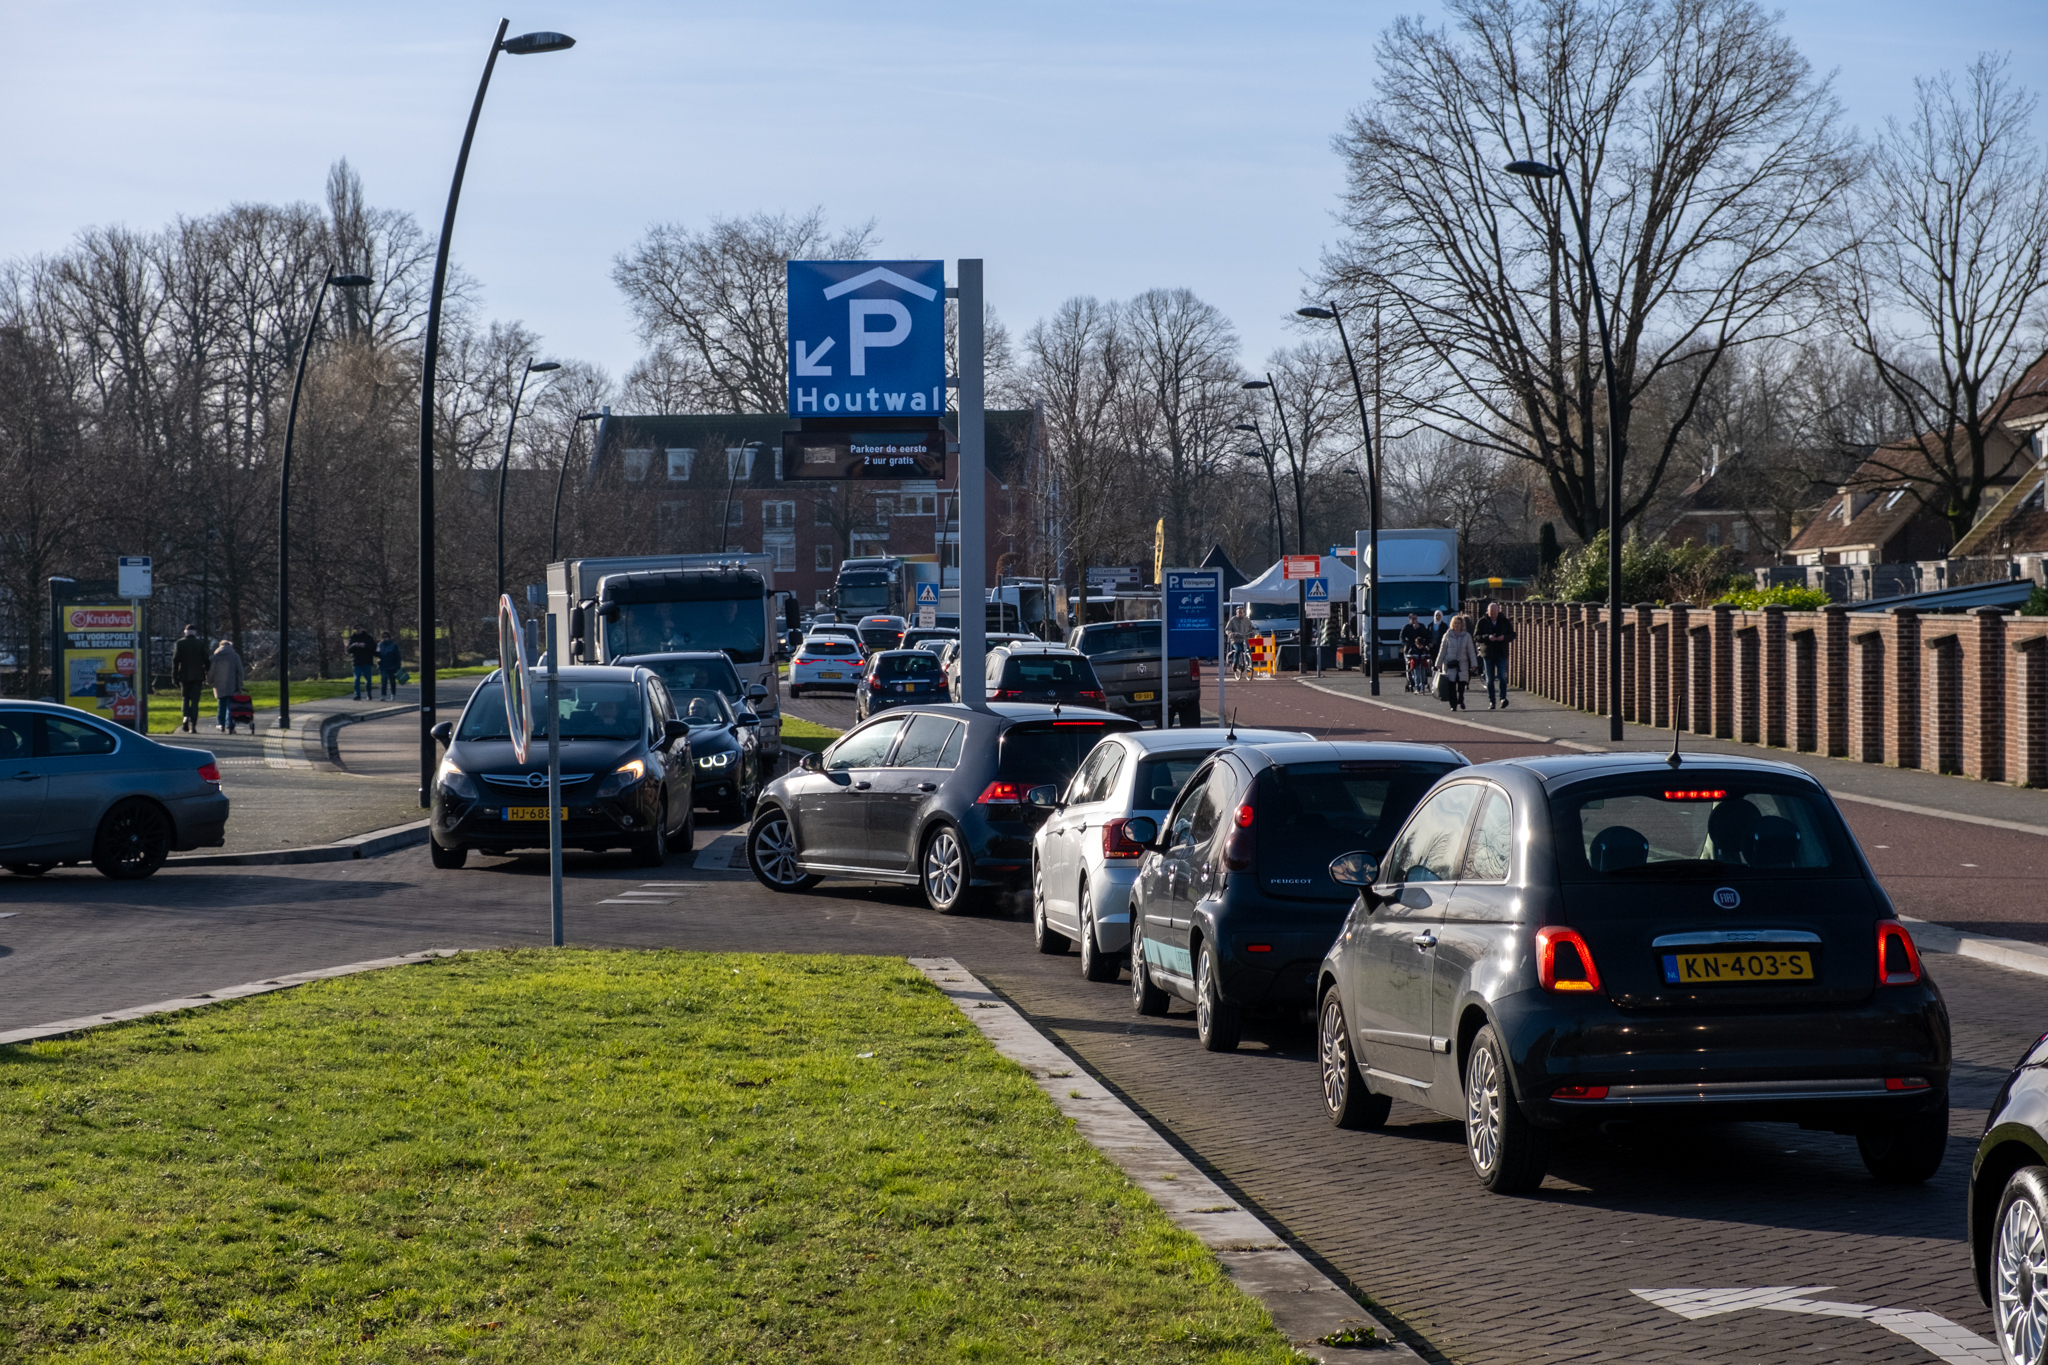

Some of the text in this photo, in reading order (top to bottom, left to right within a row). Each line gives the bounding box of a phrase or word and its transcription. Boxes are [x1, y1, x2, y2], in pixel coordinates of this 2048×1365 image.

[849, 299, 912, 376] P
[797, 386, 939, 412] Houtwal
[850, 444, 927, 453] Parkeer de eerste
[864, 456, 914, 467] 2 uur gratis
[1169, 575, 1179, 588] P
[86, 613, 132, 624] Kruidvat
[511, 808, 564, 819] HJ-688
[1719, 892, 1736, 904] FIAT
[1667, 955, 1804, 979] NL KN-403-S
